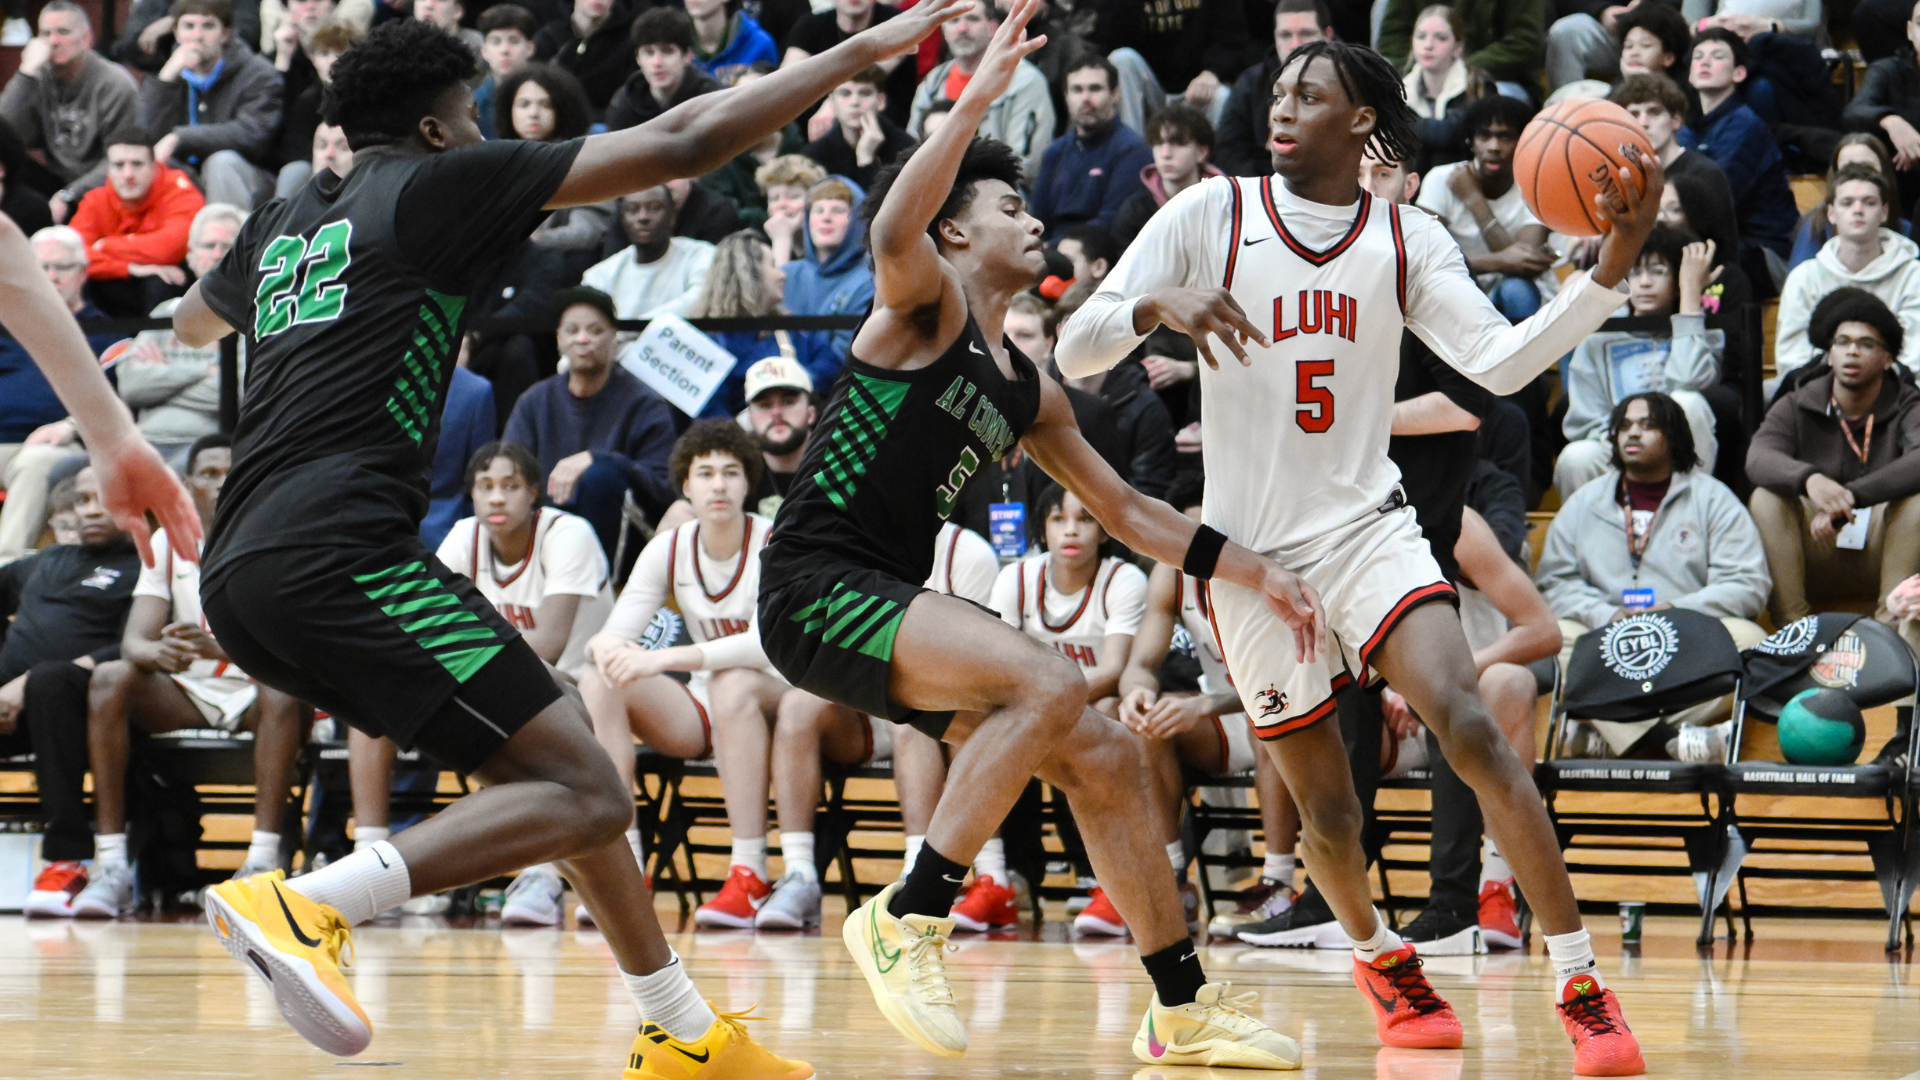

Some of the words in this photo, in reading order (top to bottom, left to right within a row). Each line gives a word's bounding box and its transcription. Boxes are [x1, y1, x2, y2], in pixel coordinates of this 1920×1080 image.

[254, 218, 352, 343] 22
[1273, 290, 1357, 343] LUHI
[638, 346, 701, 398] Section
[658, 327, 715, 374] Parent
[935, 375, 977, 420] AZ
[1295, 359, 1335, 434] 5
[936, 445, 980, 521] 5
[1623, 594, 1653, 604] STAFF
[1619, 634, 1660, 653] EYBL
[1613, 653, 1673, 681] SCHOLASTIC
[1559, 769, 1609, 779] BASKETBALL
[1611, 769, 1631, 779] HALL
[1633, 769, 1645, 779] OF
[1646, 770, 1671, 780] FAME
[1743, 771, 1794, 782] BASKETBALL
[1796, 772, 1816, 783] HALL
[1818, 773, 1830, 783] OF
[1831, 773, 1856, 784] FAME
